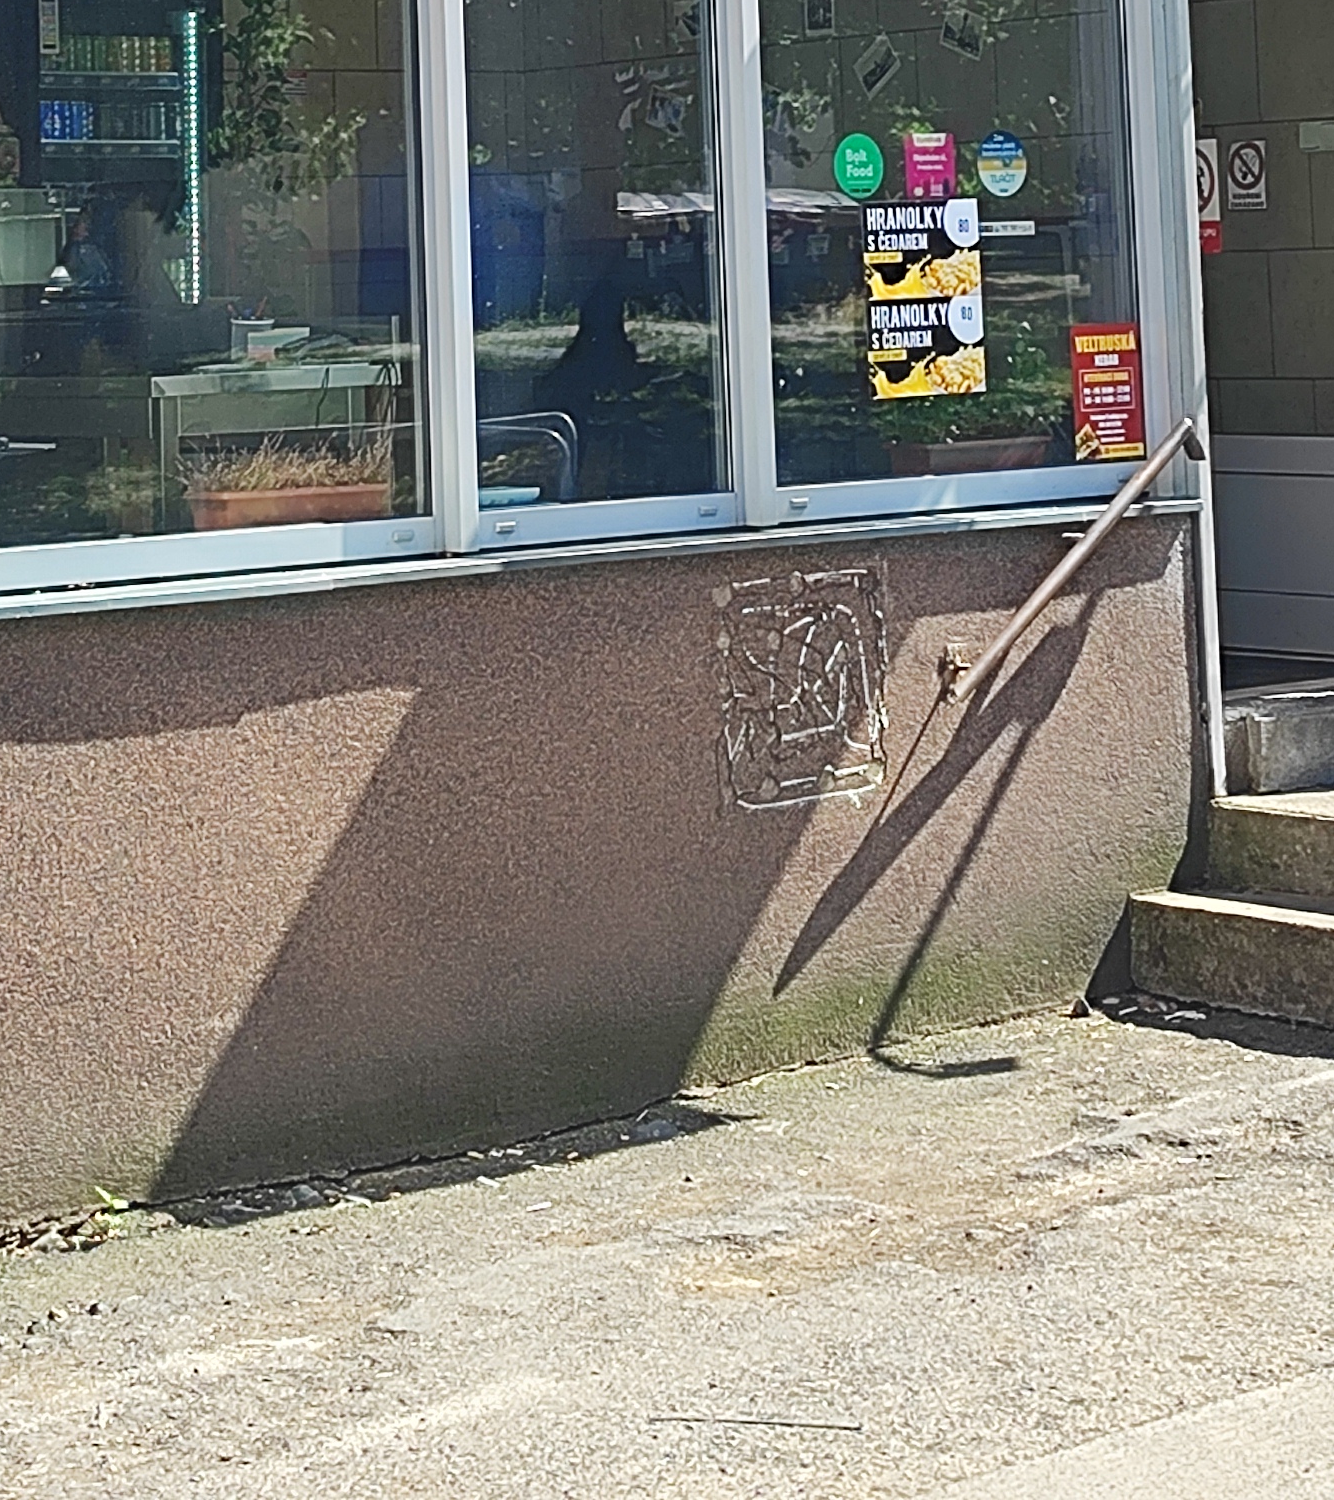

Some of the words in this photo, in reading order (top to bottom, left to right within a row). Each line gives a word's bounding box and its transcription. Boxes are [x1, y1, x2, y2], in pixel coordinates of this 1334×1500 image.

[846, 165, 874, 177] Food
[866, 206, 944, 231] HRANOLKY
[868, 237, 876, 251] S
[878, 231, 929, 250] ČEDAREM
[870, 303, 948, 329] HRANOLKY
[872, 332, 880, 349] S
[882, 328, 933, 349] ČEDAREM
[1074, 330, 1136, 353] VELTRUSKÁ
